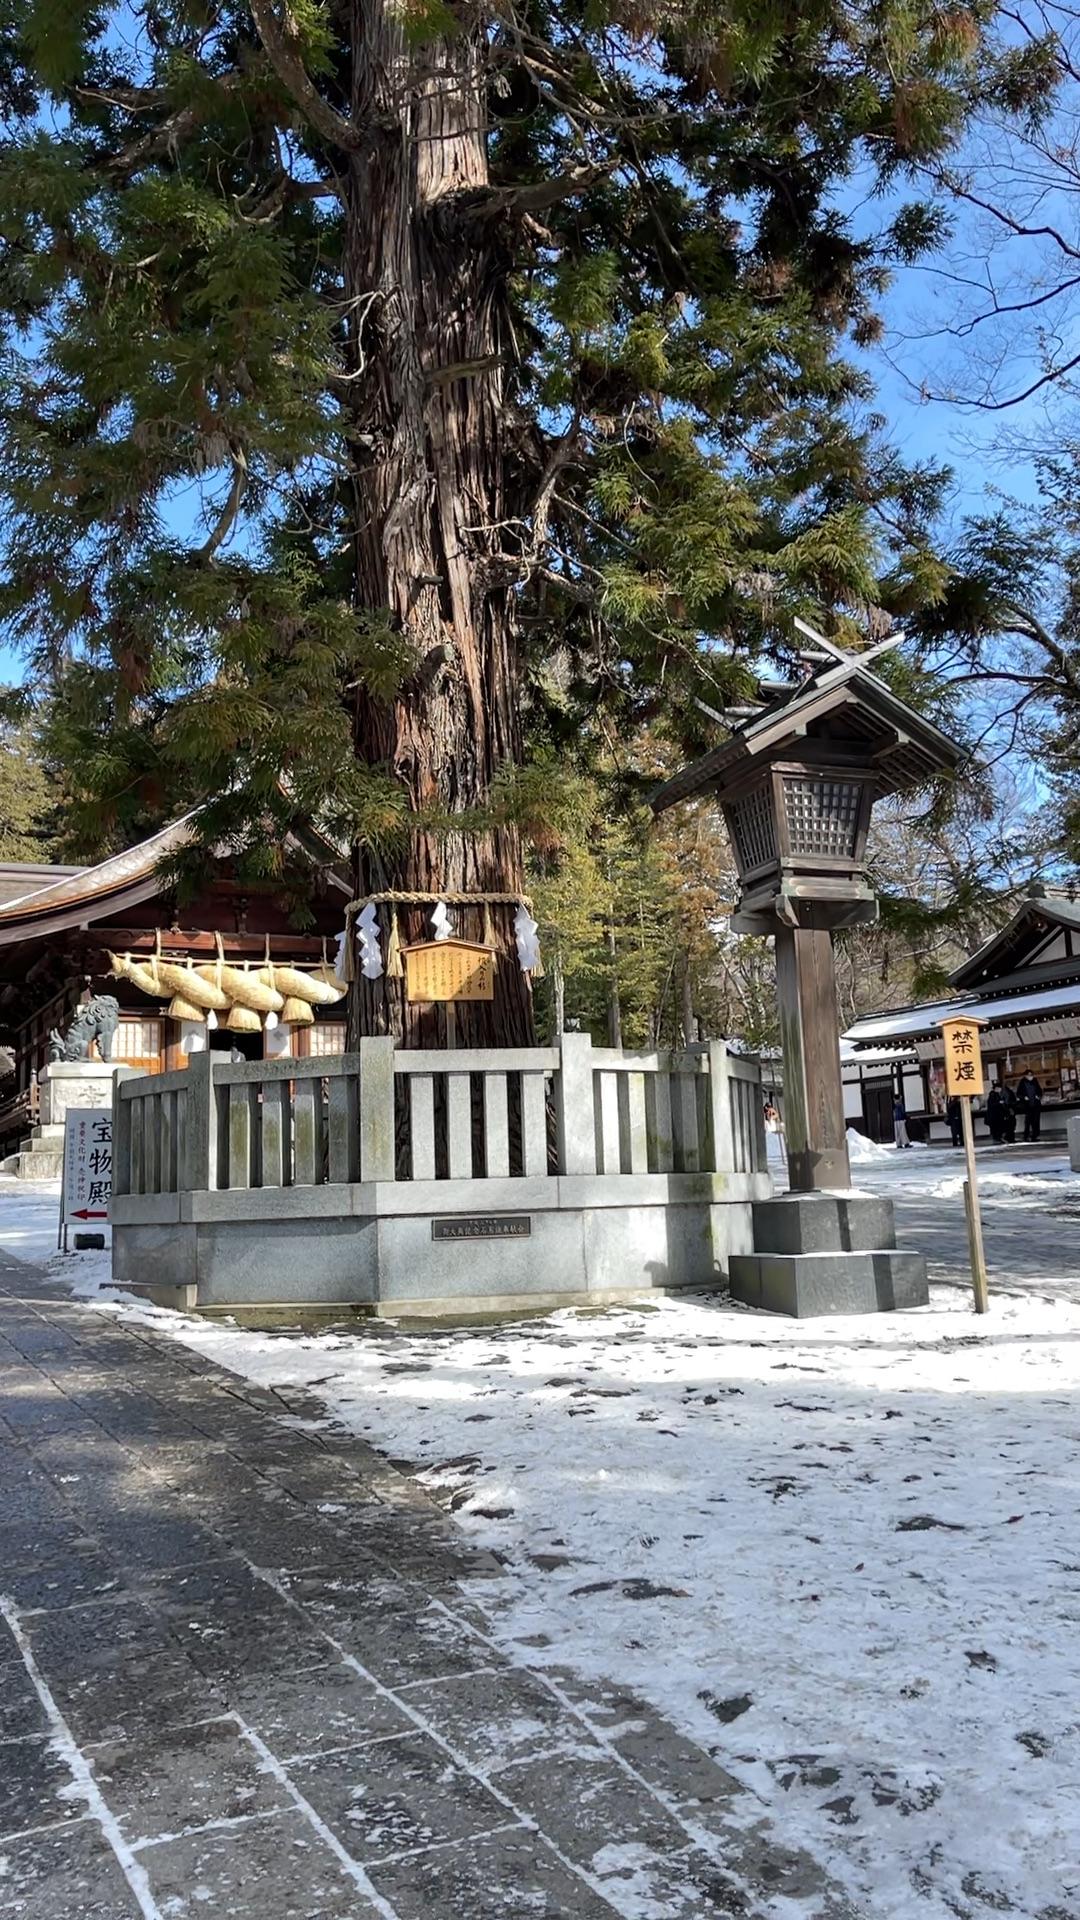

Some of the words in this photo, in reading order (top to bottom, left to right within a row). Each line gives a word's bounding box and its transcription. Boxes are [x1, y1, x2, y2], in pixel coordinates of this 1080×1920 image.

[952, 1030, 975, 1081] 禁煙
[88, 1117, 112, 1206] 宝物殿
